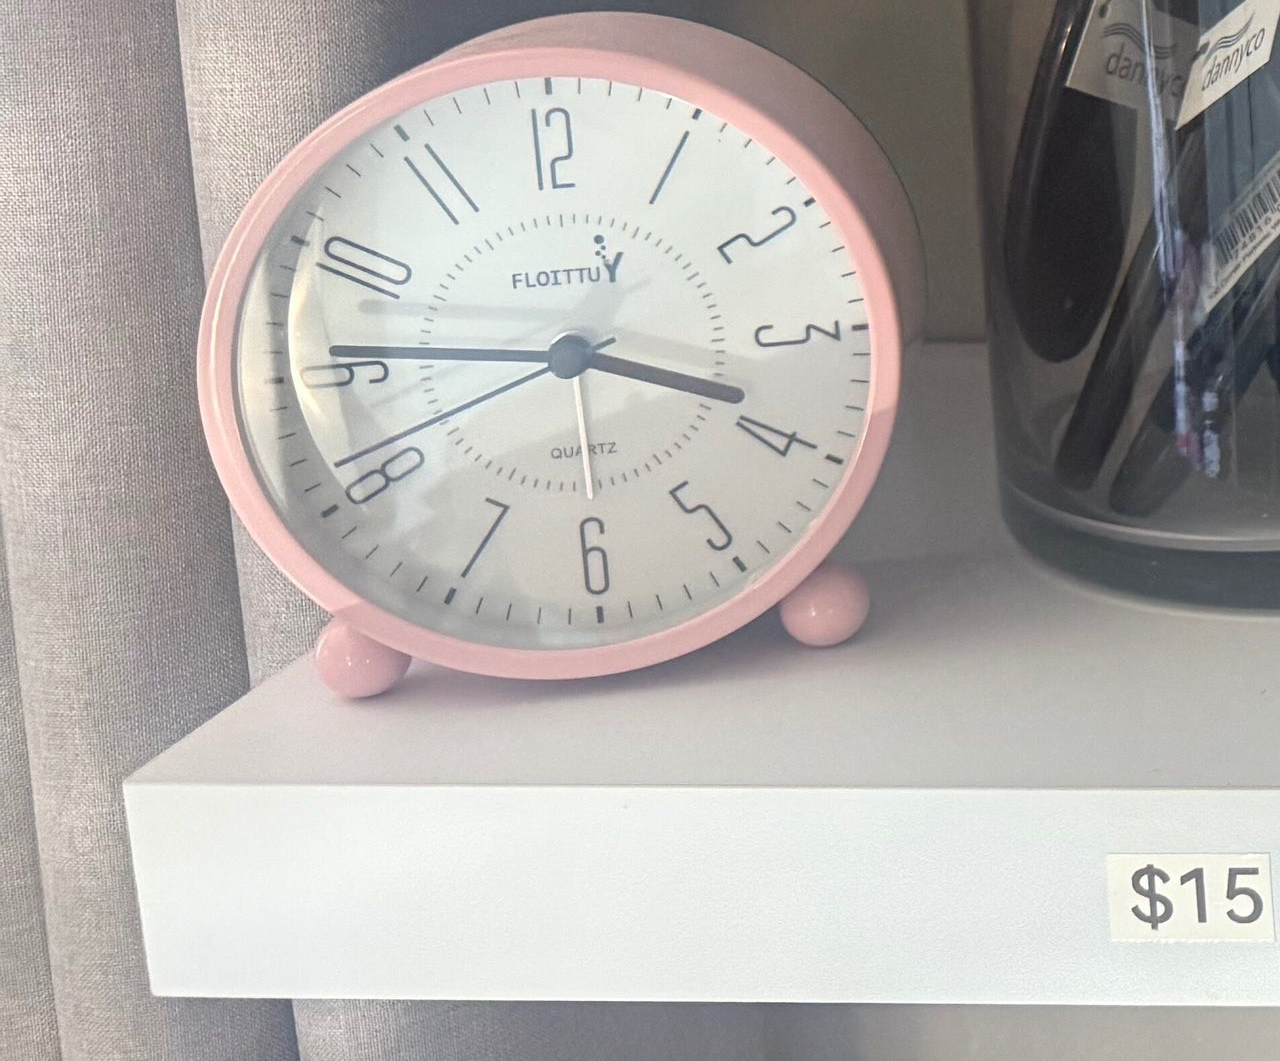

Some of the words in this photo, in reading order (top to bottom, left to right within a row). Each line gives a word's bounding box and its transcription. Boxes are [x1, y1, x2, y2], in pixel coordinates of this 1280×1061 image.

[1201, 27, 1266, 92] dannyco
[531, 107, 576, 190] 12
[404, 143, 480, 225] 11
[717, 206, 797, 265] 2
[316, 236, 412, 300] 10
[754, 320, 841, 348] 3
[300, 360, 389, 389] 9
[550, 441, 617, 459] QUARTZ
[736, 414, 818, 457] 4
[345, 446, 425, 505] 8
[460, 497, 510, 578] 7
[669, 480, 733, 552] 5
[579, 516, 610, 596] 6
[1131, 864, 1264, 930] $15
